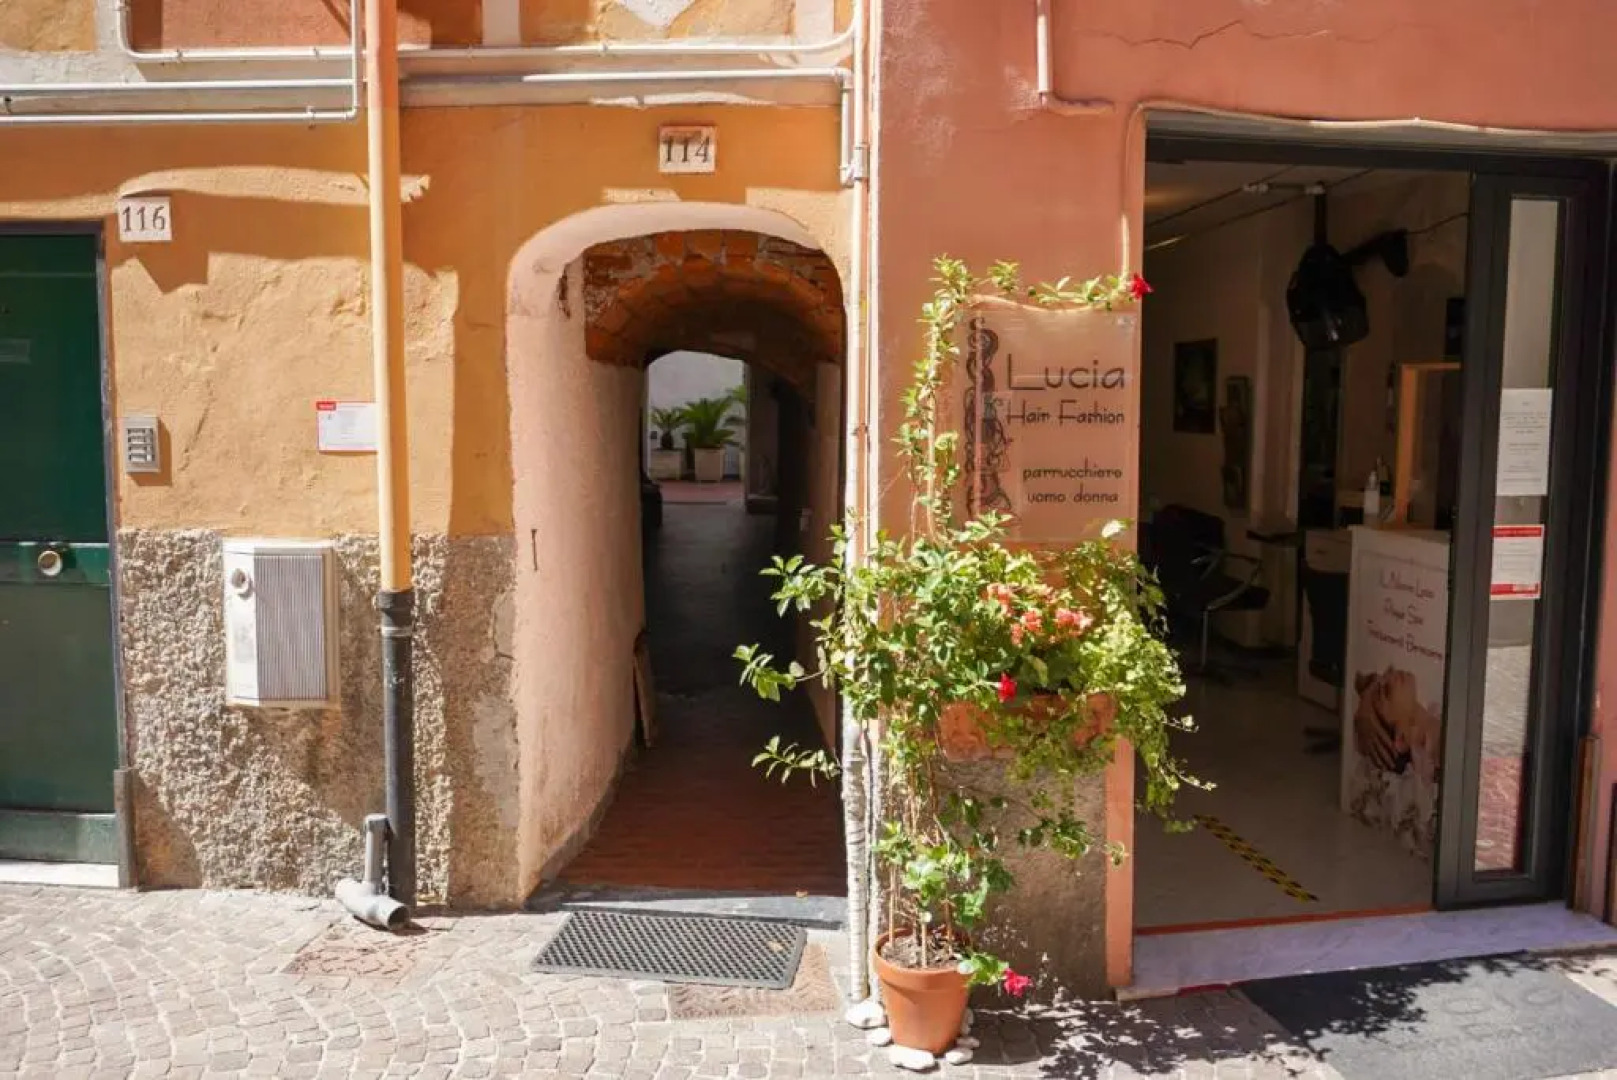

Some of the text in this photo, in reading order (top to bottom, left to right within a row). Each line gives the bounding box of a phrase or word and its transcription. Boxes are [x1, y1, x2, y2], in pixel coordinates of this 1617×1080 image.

[662, 135, 710, 163] 114
[122, 205, 166, 232] 116
[1007, 353, 1125, 390] Lucia
[1006, 399, 1125, 425] Hair Fashion
[1022, 456, 1123, 483] parrucchiere
[1027, 482, 1119, 503] uomo donna
